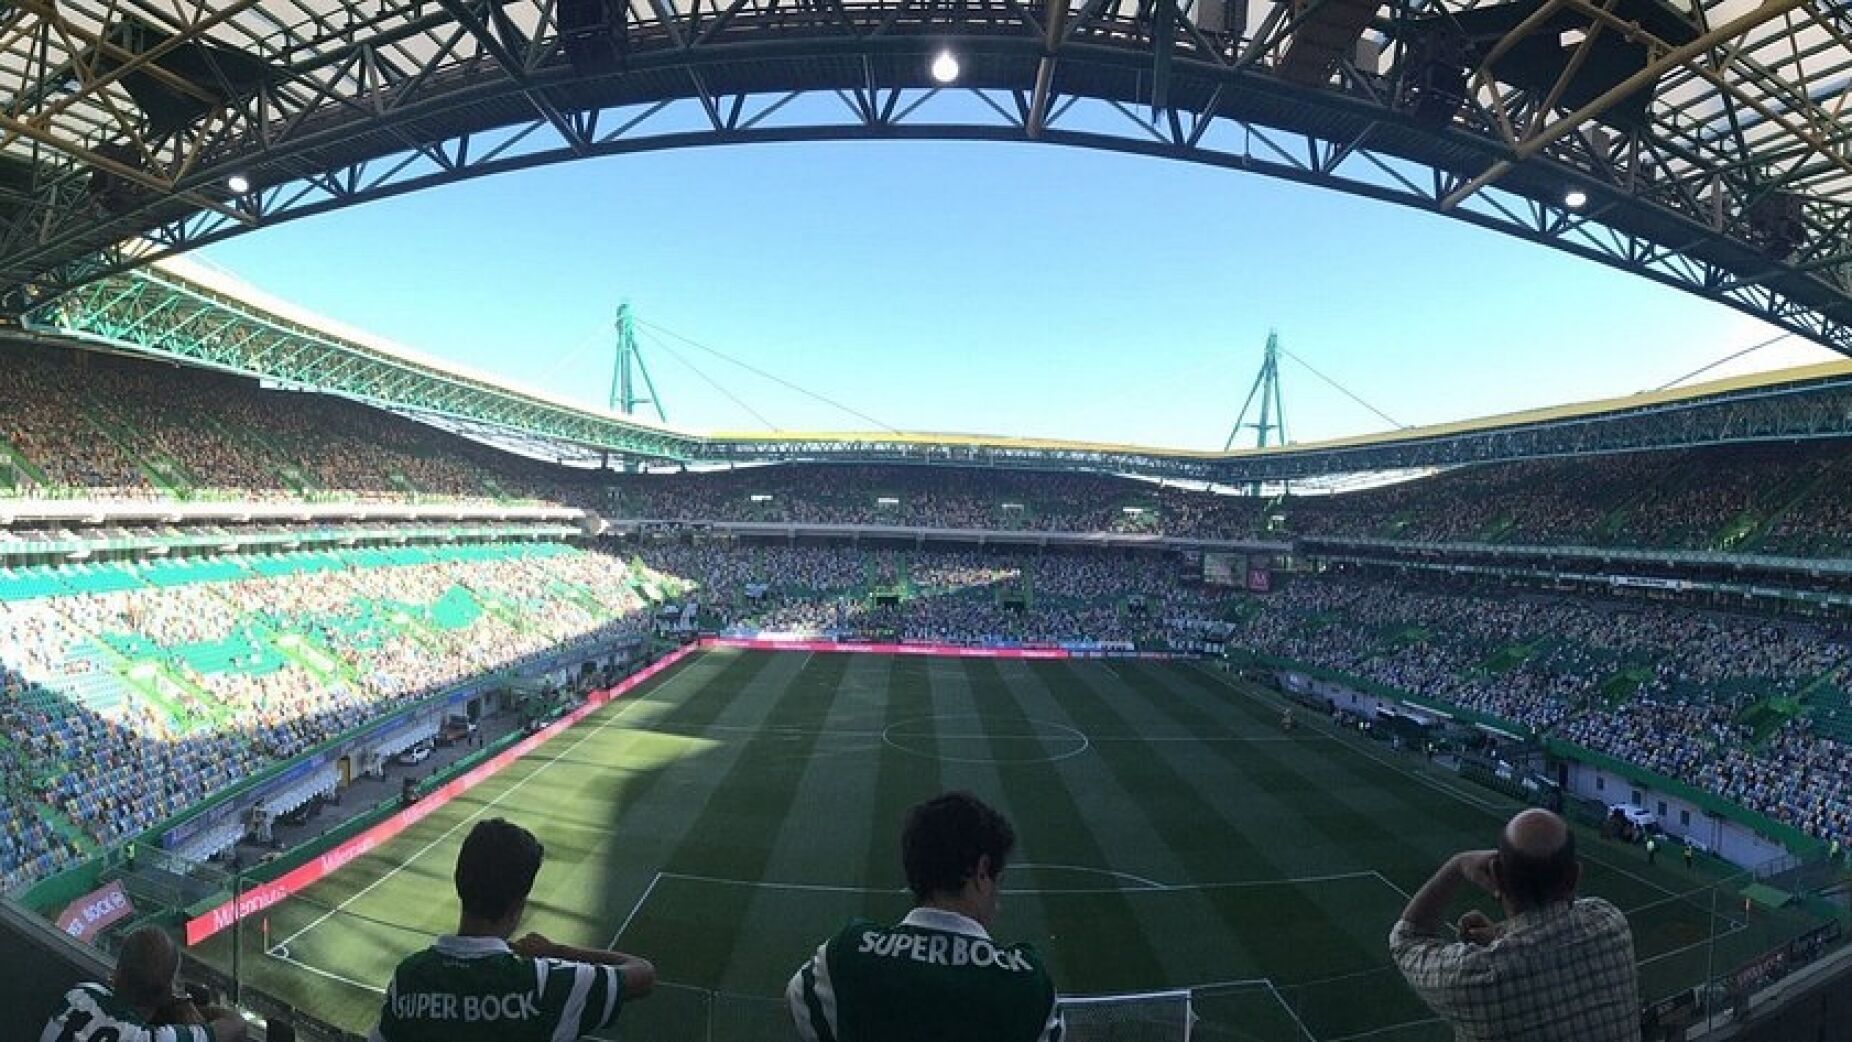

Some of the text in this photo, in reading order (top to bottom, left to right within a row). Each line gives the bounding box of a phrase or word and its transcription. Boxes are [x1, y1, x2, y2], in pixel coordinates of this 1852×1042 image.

[858, 931, 1034, 972] SUPER BOCK
[396, 991, 540, 1022] SUPER BOCK
